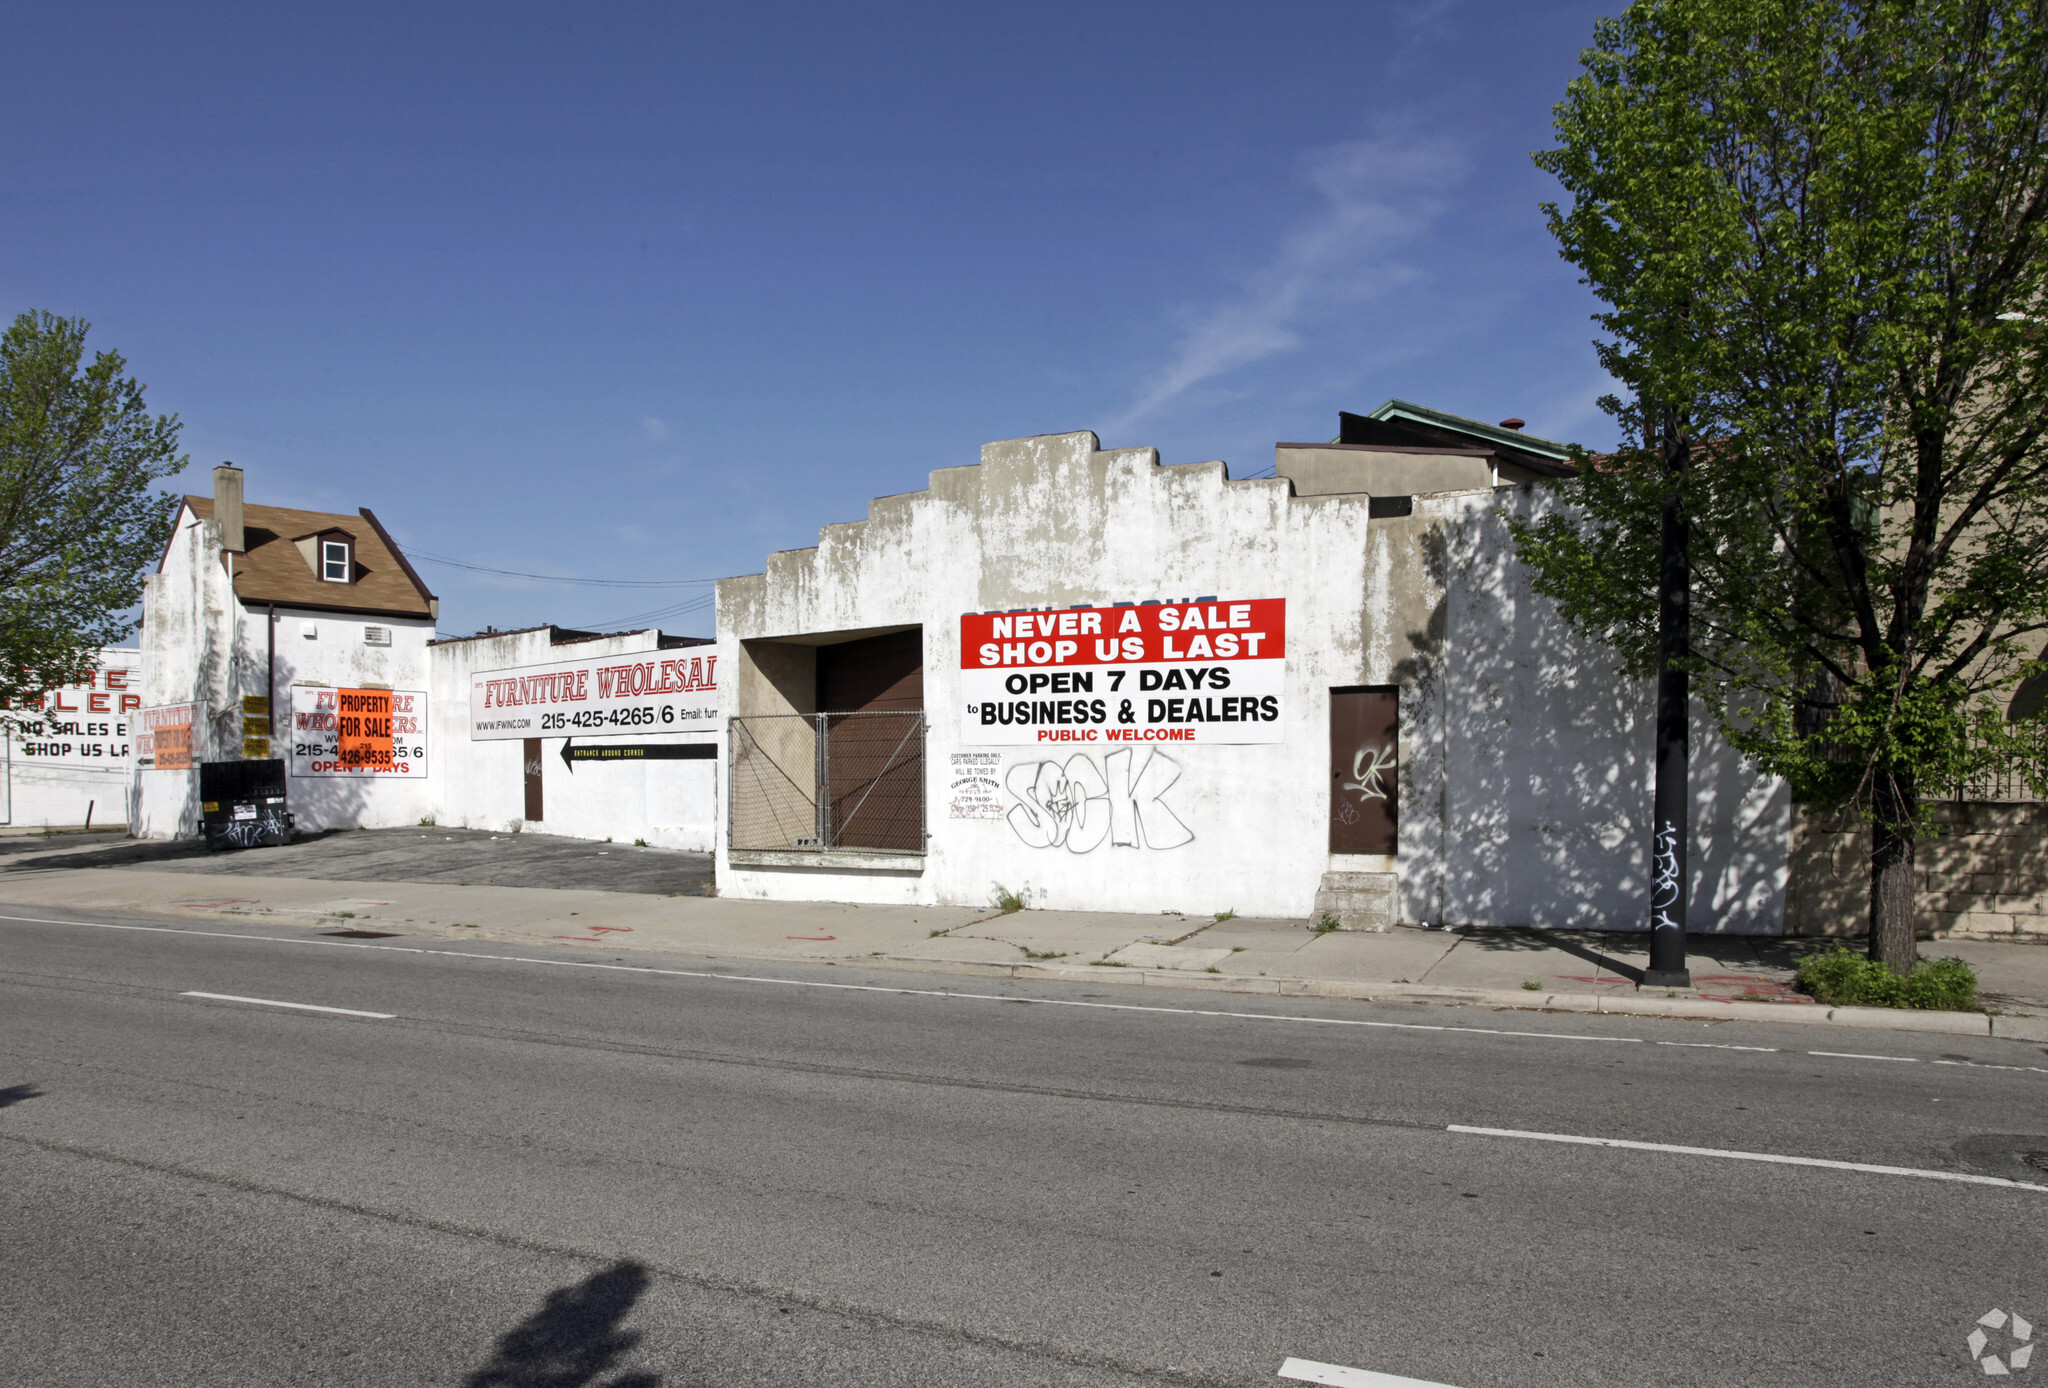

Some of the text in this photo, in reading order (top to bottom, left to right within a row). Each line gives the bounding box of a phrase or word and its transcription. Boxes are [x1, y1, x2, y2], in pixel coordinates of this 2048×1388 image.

[993, 604, 1250, 638] NEVER A SALE
[979, 632, 1266, 665] SHOP US LAST
[485, 670, 589, 708] FURNITURE
[1005, 667, 1231, 695] OPEN 7 DAYS
[341, 695, 389, 713] PROPERTY
[967, 696, 1279, 725] to BUSINESS & DEALERS
[541, 705, 675, 730] 215-425-4265/6
[681, 708, 702, 719] Email:
[52, 721, 109, 736] SALES
[339, 717, 390, 738] FOR SALE
[1037, 728, 1195, 742] PUBLIC WELCOME
[25, 743, 71, 756] SHOP
[81, 743, 102, 757] US
[341, 749, 390, 765] 426-9535
[624, 749, 644, 757] CORNER
[951, 777, 1000, 789] GEORGE SMITH
